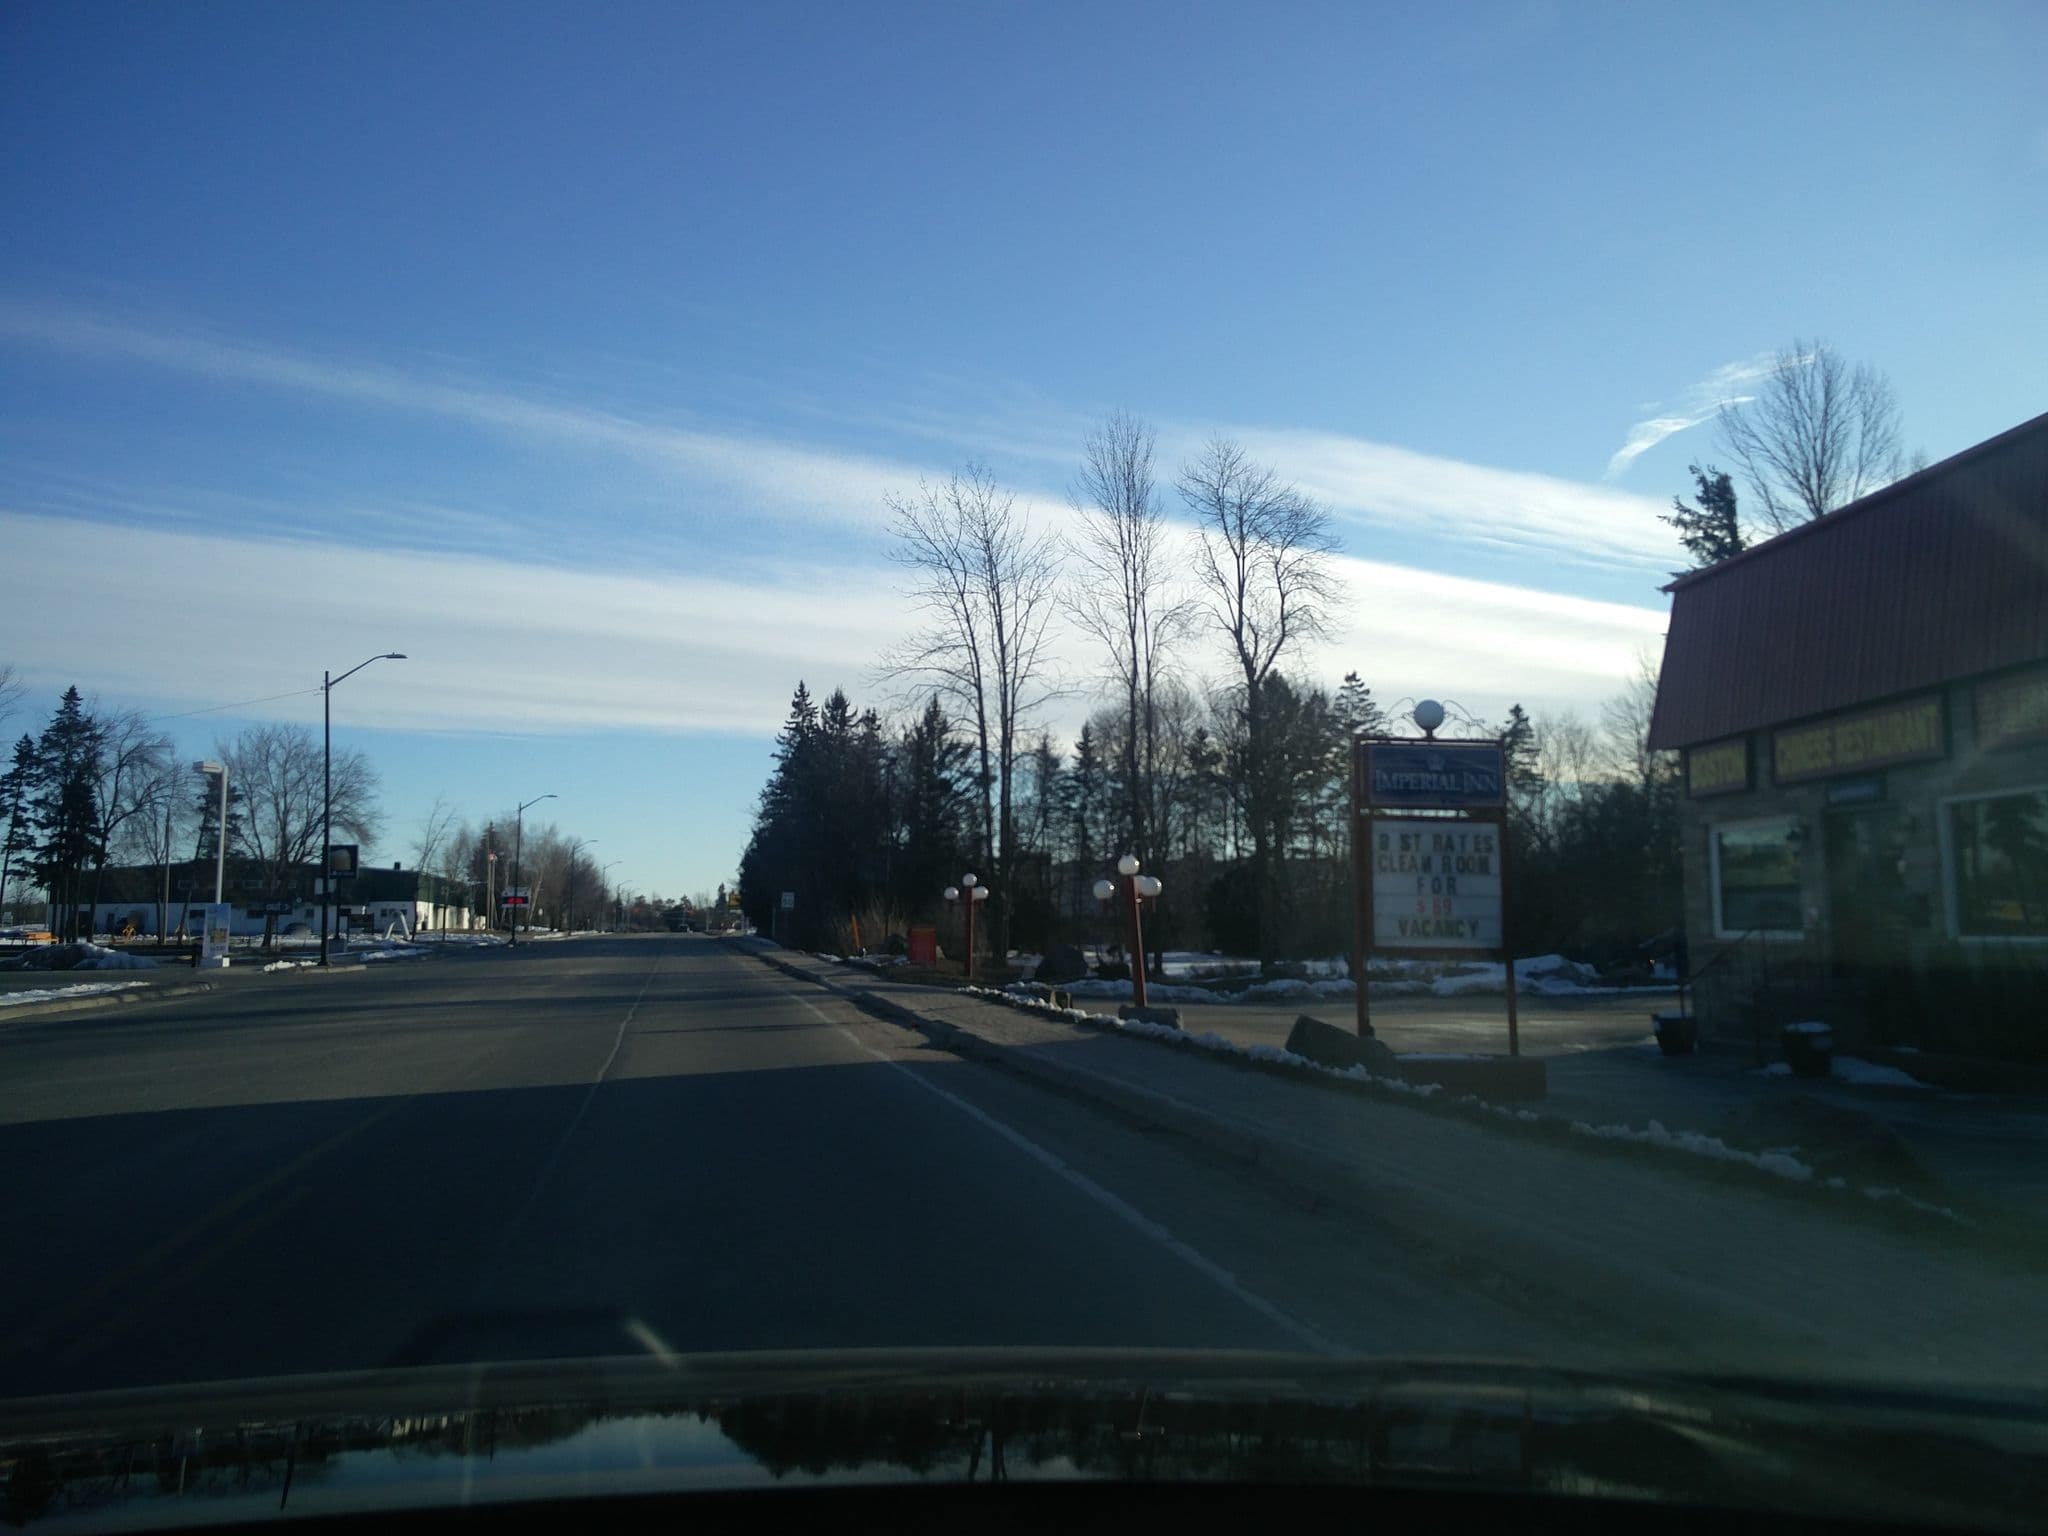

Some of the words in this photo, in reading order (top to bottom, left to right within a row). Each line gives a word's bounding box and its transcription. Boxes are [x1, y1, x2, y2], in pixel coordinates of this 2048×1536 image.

[1376, 769, 1460, 792] IMPERIAL
[1463, 771, 1499, 793] INN
[1432, 834, 1494, 853] RATES
[1377, 855, 1432, 873] CLEAN
[1441, 856, 1491, 875] ROOM
[1416, 876, 1457, 895] FOR
[1398, 919, 1480, 938] VACANCY
